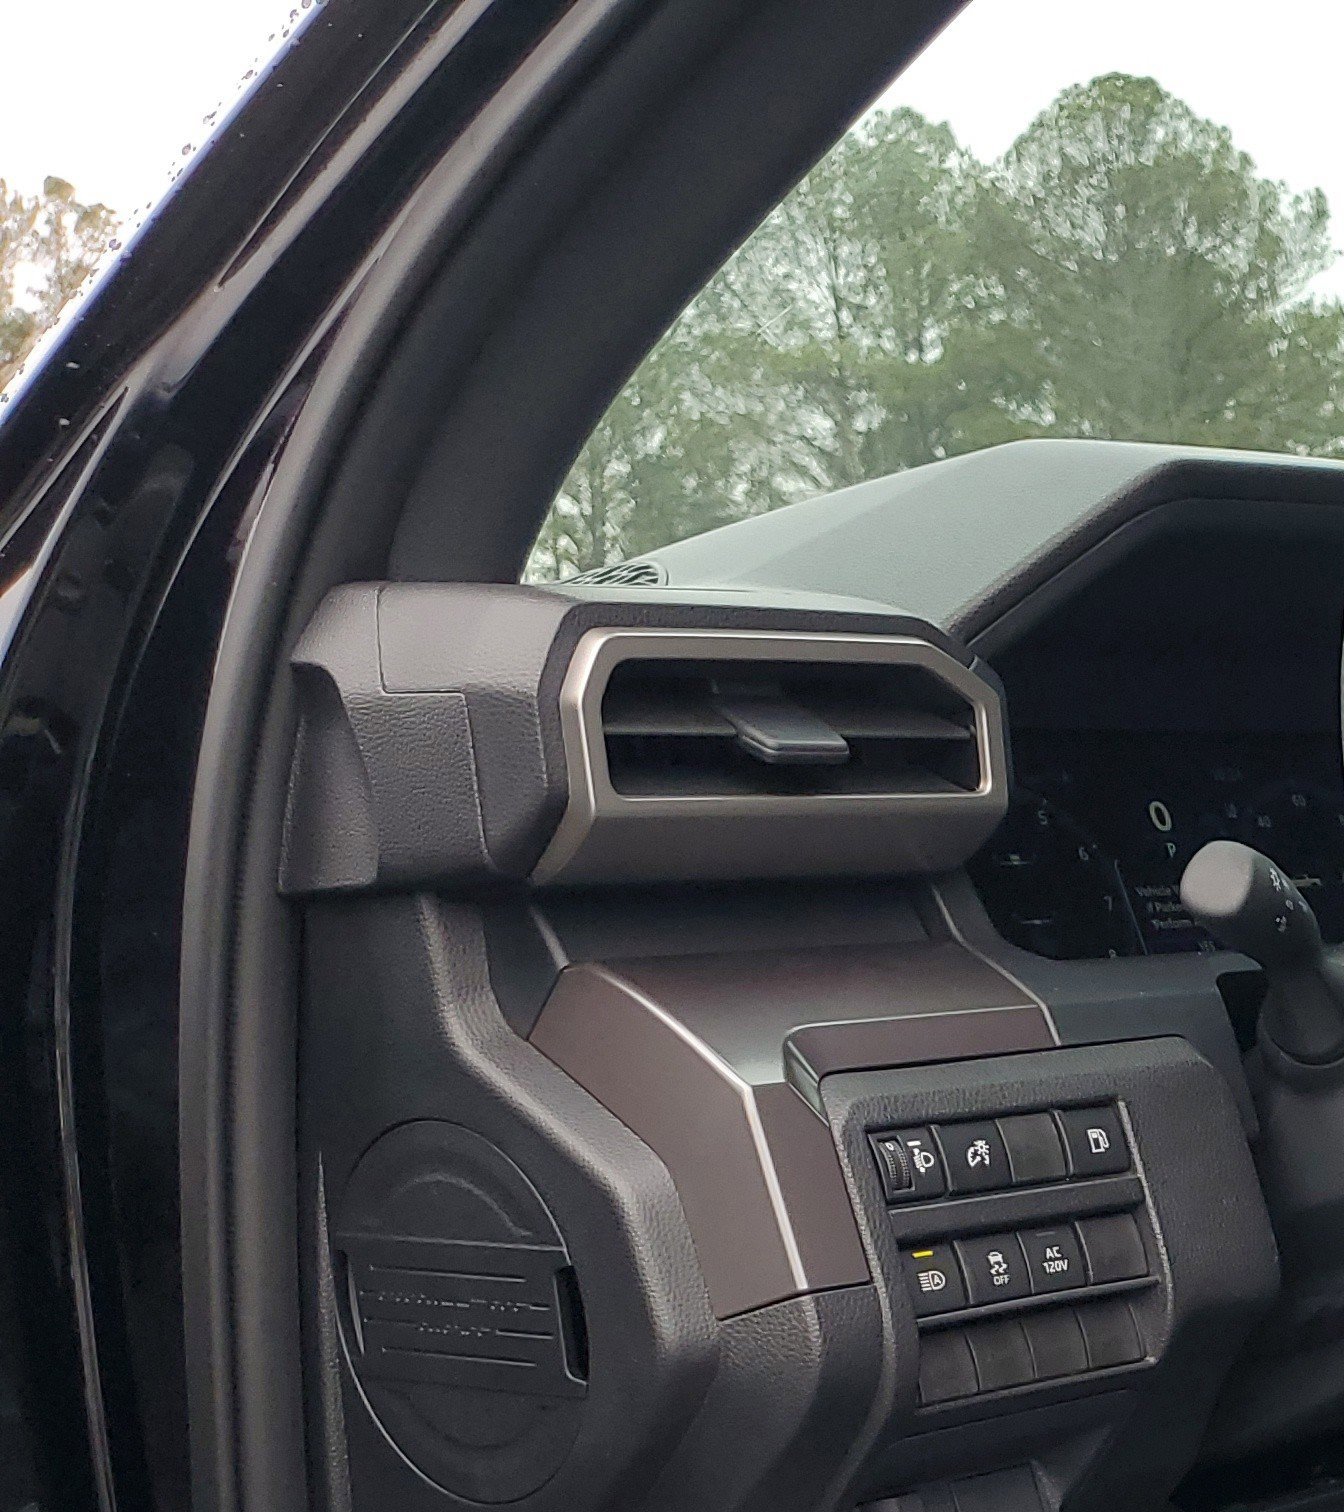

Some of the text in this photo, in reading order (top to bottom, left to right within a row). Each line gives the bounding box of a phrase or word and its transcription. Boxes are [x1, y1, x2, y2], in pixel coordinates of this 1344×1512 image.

[1148, 800, 1172, 832] 0
[1165, 842, 1177, 858] P
[1045, 1246, 1062, 1259] AC
[1042, 1258, 1069, 1274] 120V
[993, 1274, 1010, 1286] OFF
